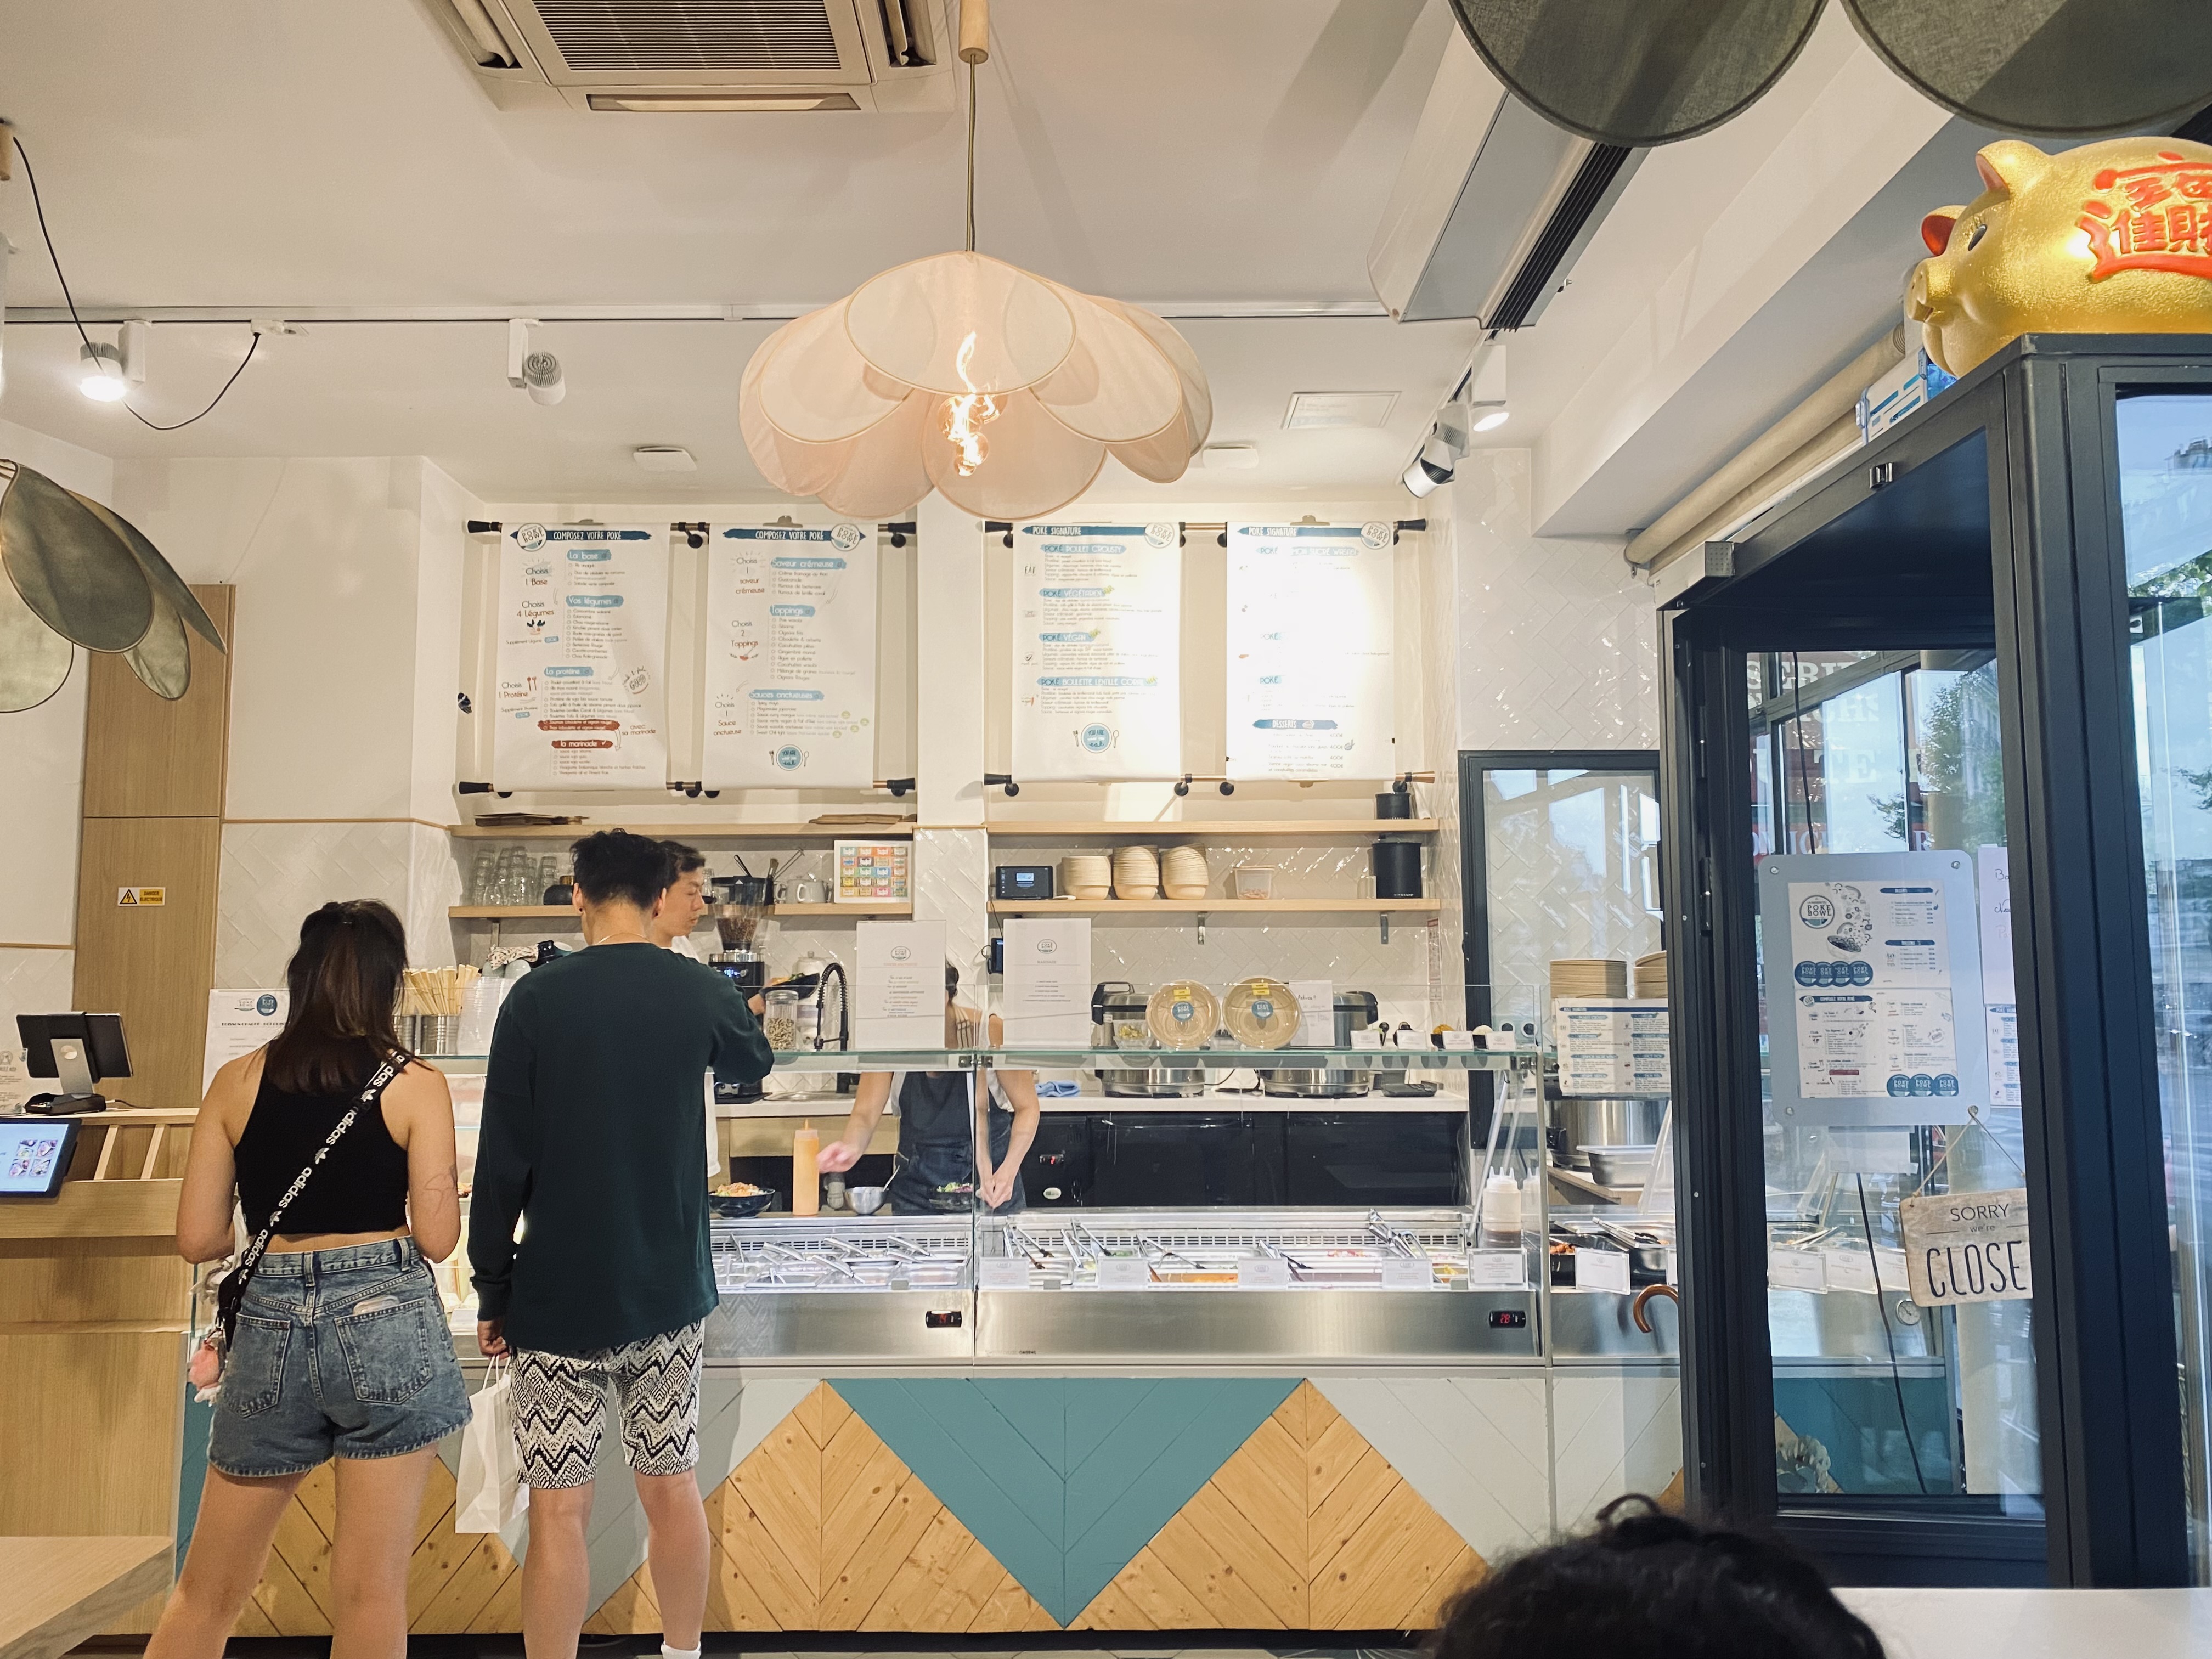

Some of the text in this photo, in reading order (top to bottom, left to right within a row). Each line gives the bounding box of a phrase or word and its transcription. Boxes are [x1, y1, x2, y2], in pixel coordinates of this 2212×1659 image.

[1051, 526, 1081, 535] SIGNATURE
[1266, 527, 1297, 537] SIGNATURE
[554, 531, 584, 540] COMPOSEZ
[586, 531, 604, 540] VOTRE
[755, 531, 786, 539] COMPOSEZ
[789, 532, 807, 540] VOTRE
[800, 560, 833, 568] crémeuse
[525, 567, 549, 575] Choisis
[522, 600, 545, 608] Choisis
[584, 596, 611, 607] légumes
[525, 610, 554, 618] Légumes
[772, 605, 803, 616] Toppings
[731, 640, 758, 648] Toppings
[556, 668, 580, 676] protéine
[1062, 678, 1093, 686] BOULETTE
[1272, 720, 1297, 729] DESSERTS
[278, 1167, 312, 1209] adidas
[1950, 1203, 2009, 1222] SORRY
[1970, 1224, 1995, 1233] we're
[245, 1229, 268, 1267] adidas
